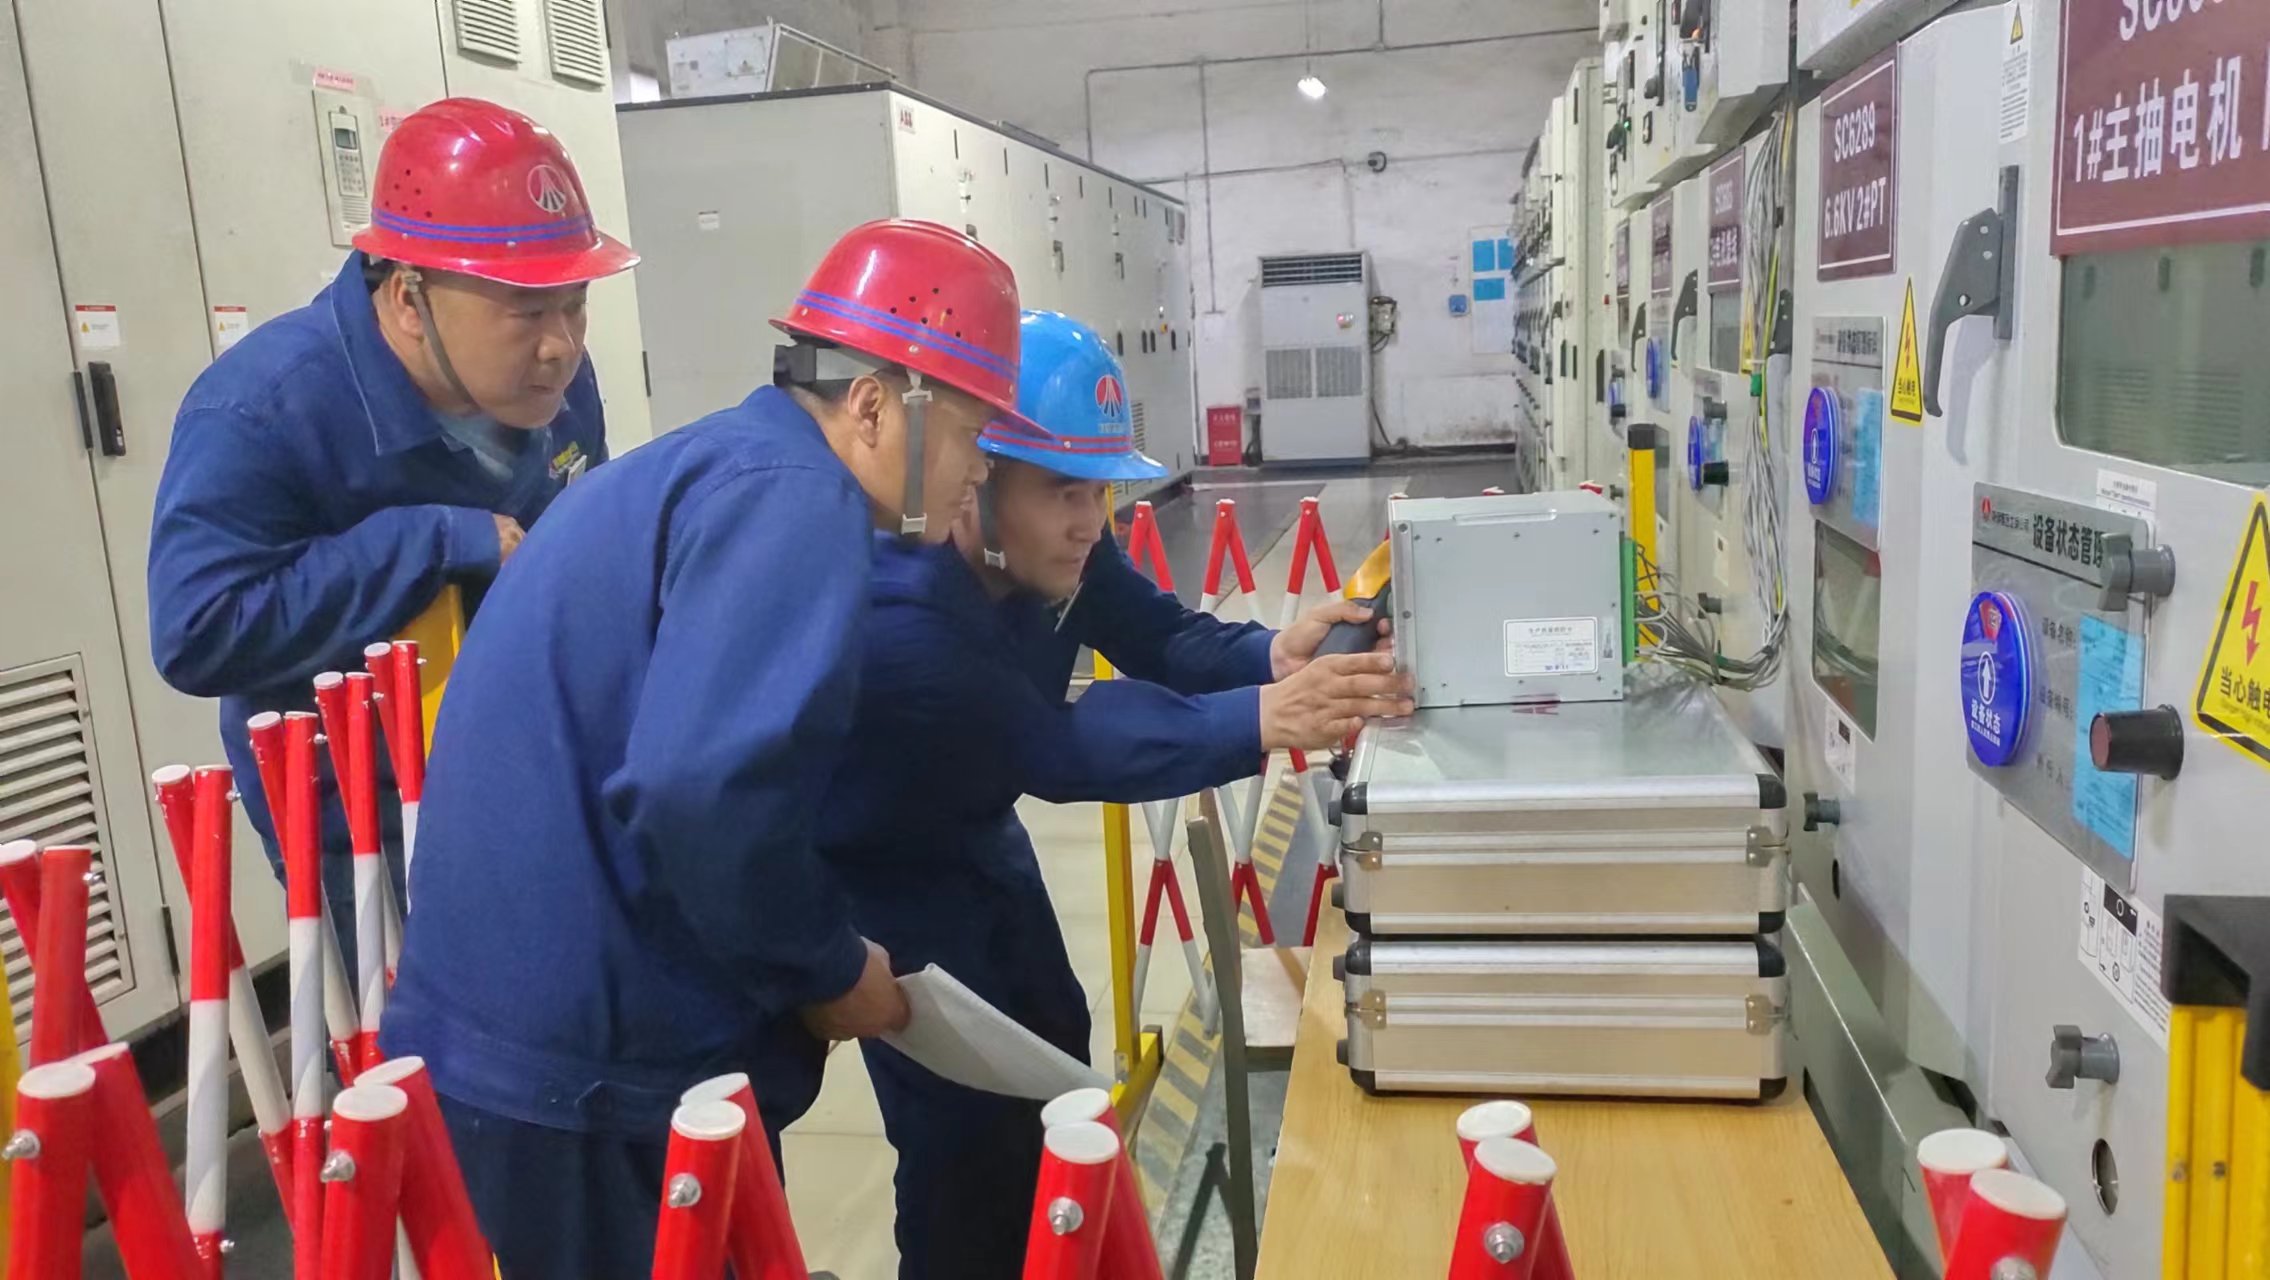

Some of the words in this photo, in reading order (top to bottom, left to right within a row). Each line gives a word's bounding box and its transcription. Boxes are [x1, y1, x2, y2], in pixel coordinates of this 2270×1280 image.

[1834, 101, 1877, 163] SC6289
[2073, 56, 2243, 183] 1#主抽电机
